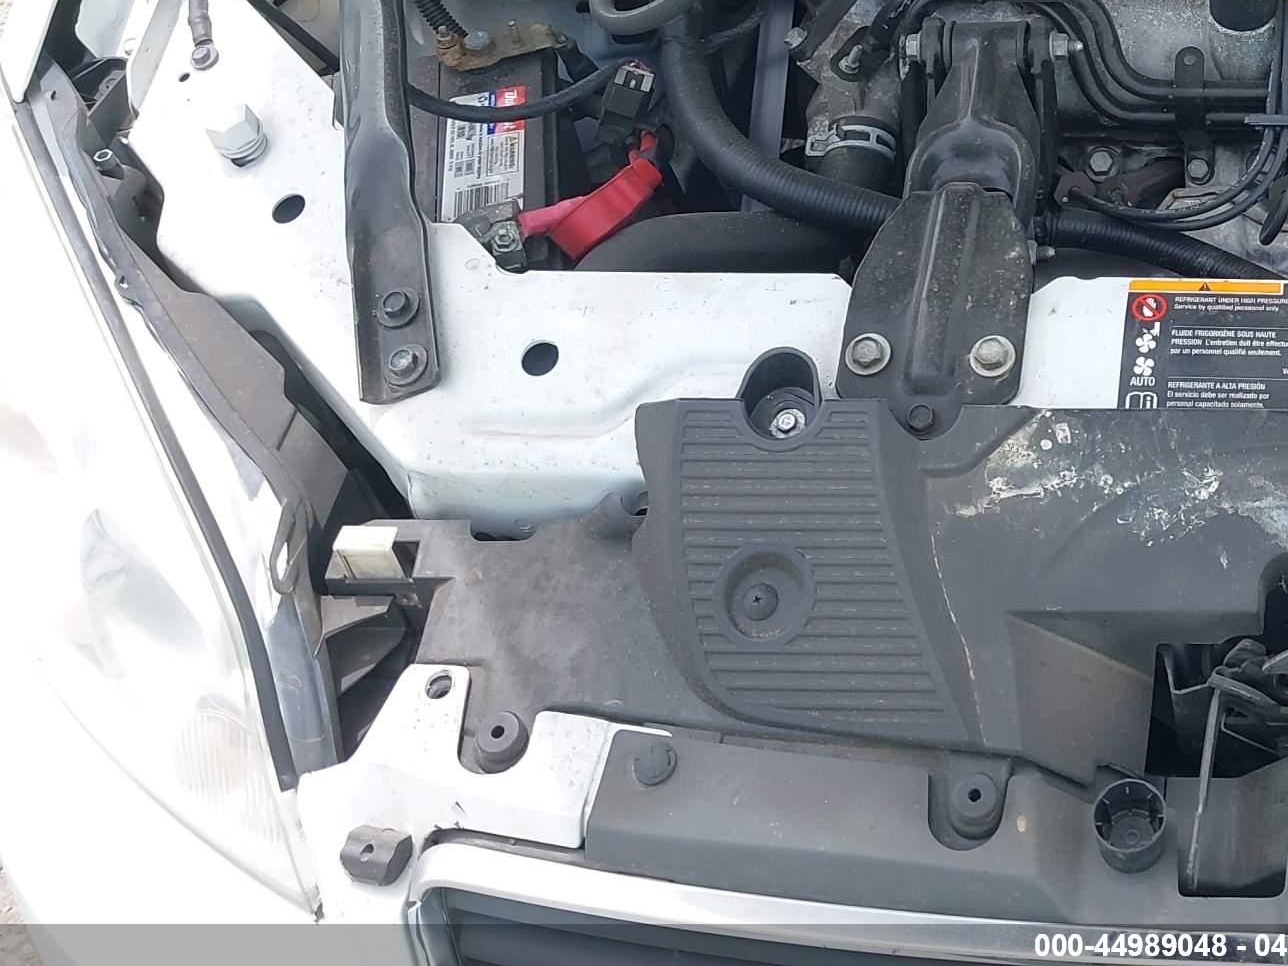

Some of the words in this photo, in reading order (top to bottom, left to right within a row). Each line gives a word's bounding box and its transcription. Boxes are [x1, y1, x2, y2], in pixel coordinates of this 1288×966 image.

[1175, 296, 1216, 304] REFRIGERANT
[1223, 348, 1246, 356] qualifié
[1130, 376, 1155, 387] AUTO
[1168, 381, 1215, 389] REFRIGERANTE
[1238, 382, 1265, 390] PRESIÓN
